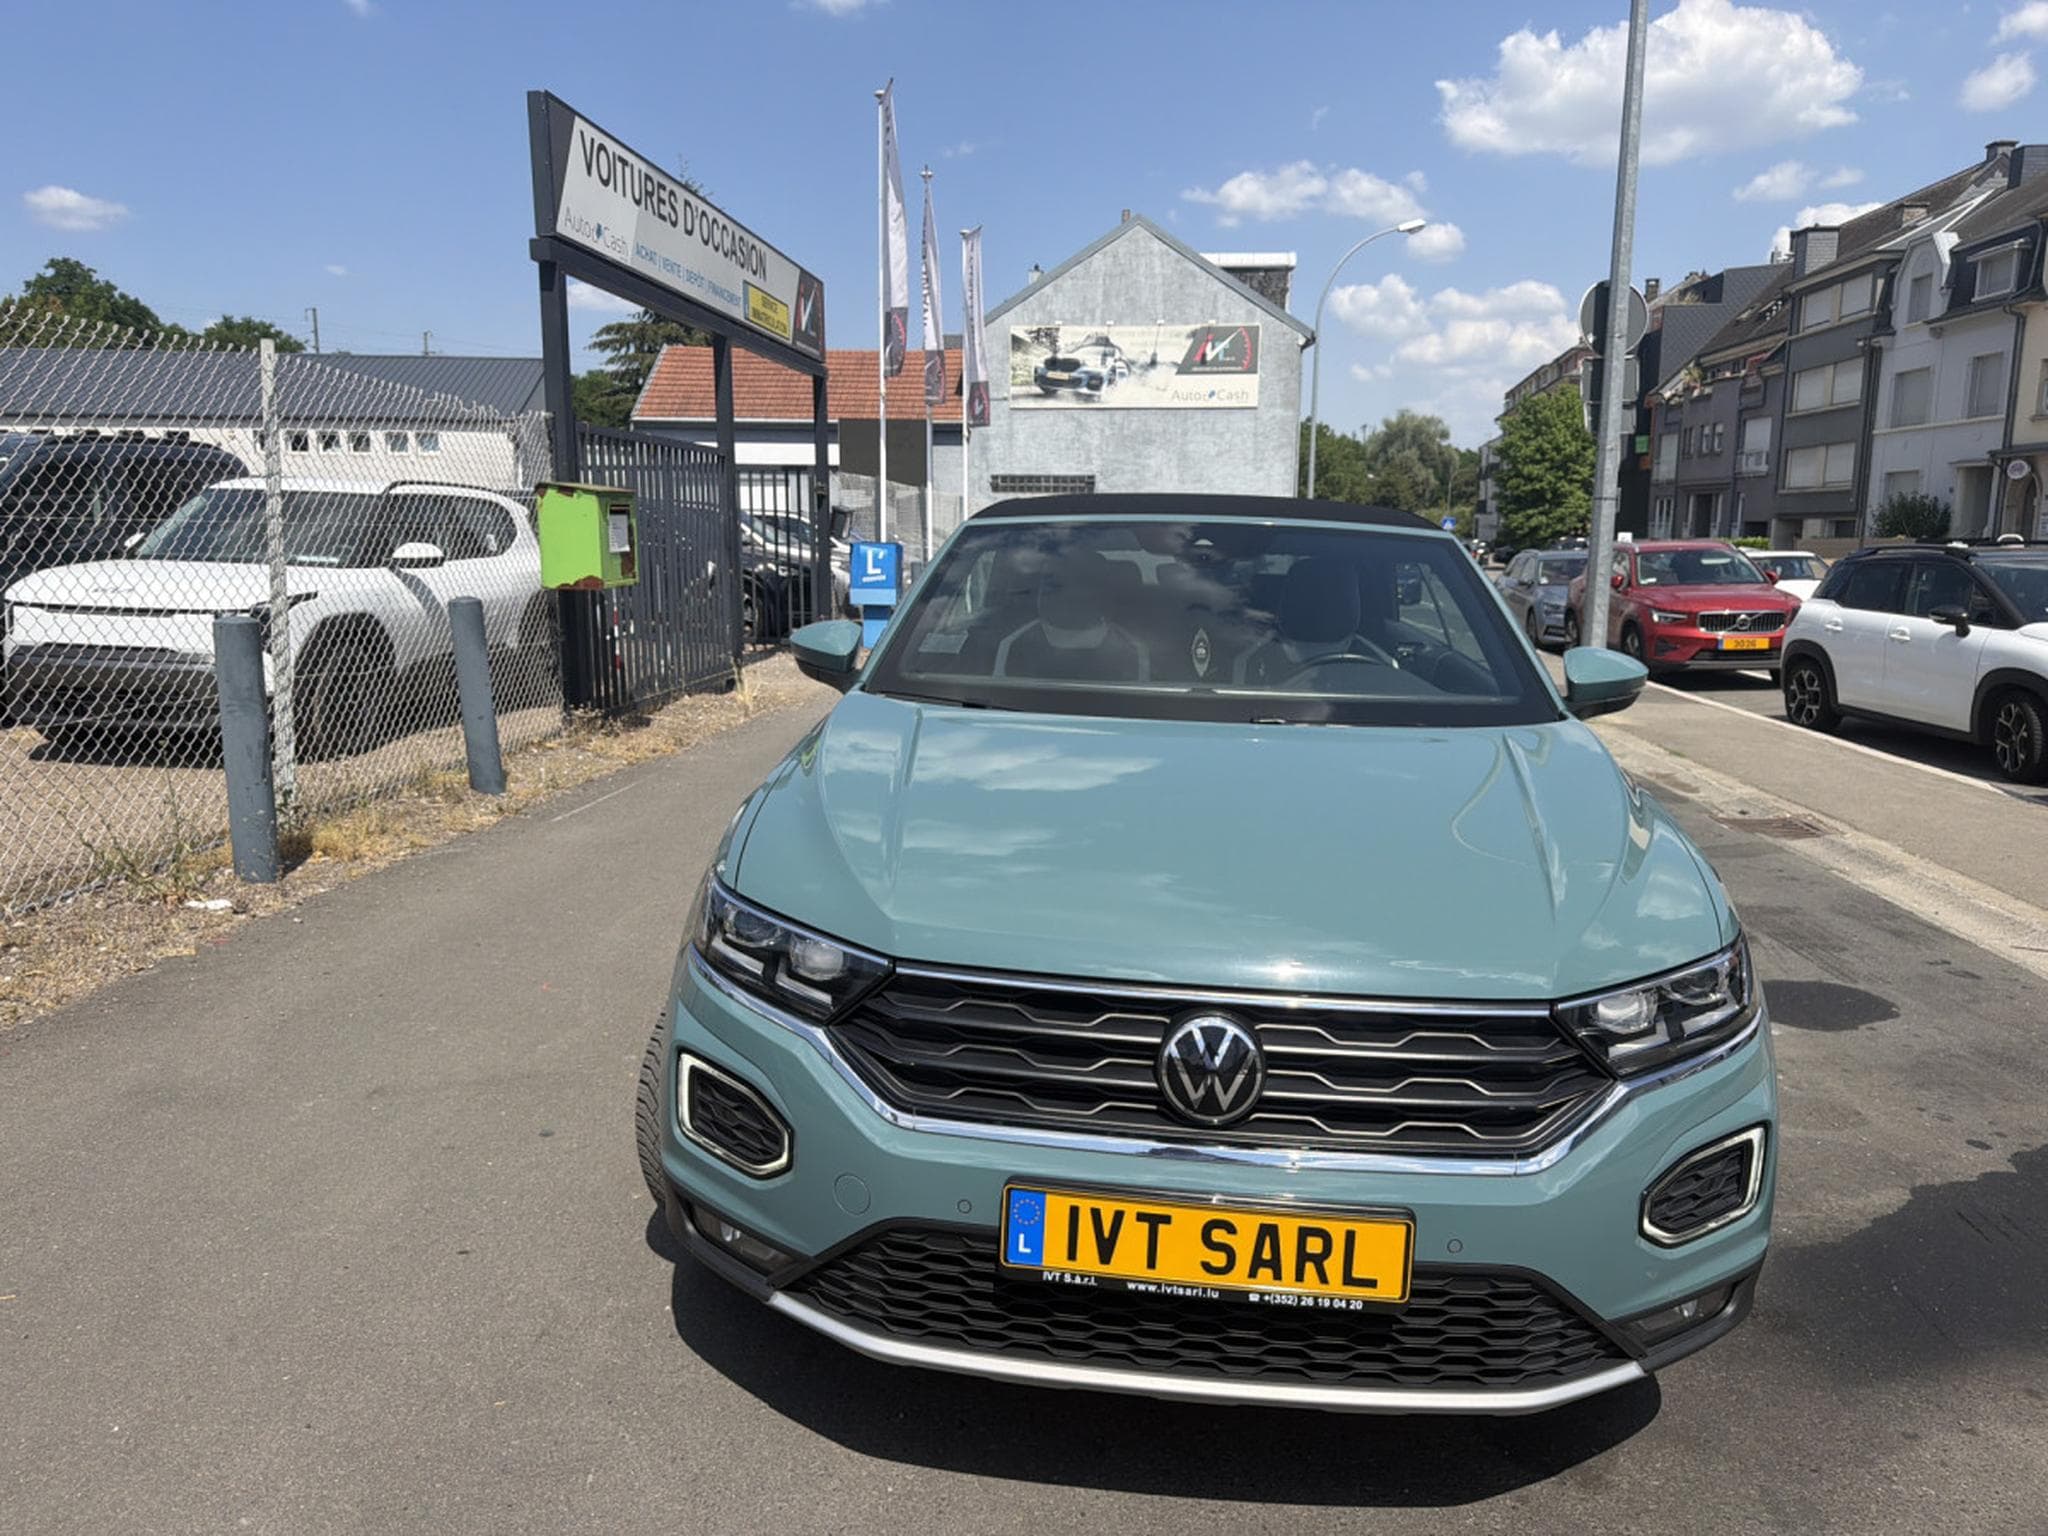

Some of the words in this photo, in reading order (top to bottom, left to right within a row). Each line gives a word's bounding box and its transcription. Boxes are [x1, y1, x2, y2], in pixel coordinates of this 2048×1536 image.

[579, 129, 679, 228] VOITURES
[683, 199, 768, 281] D'OCCASION
[1018, 1233, 1032, 1254] L
[1067, 1204, 1173, 1271] IVT
[1200, 1217, 1379, 1290] SARL
[1042, 1270, 1062, 1282] IVT
[1126, 1281, 1220, 1299] www.ivtsarl.lu
[1300, 1295, 1314, 1306] 26
[1317, 1296, 1331, 1308] 19
[1333, 1298, 1347, 1309] 04
[1349, 1300, 1364, 1311] 20
